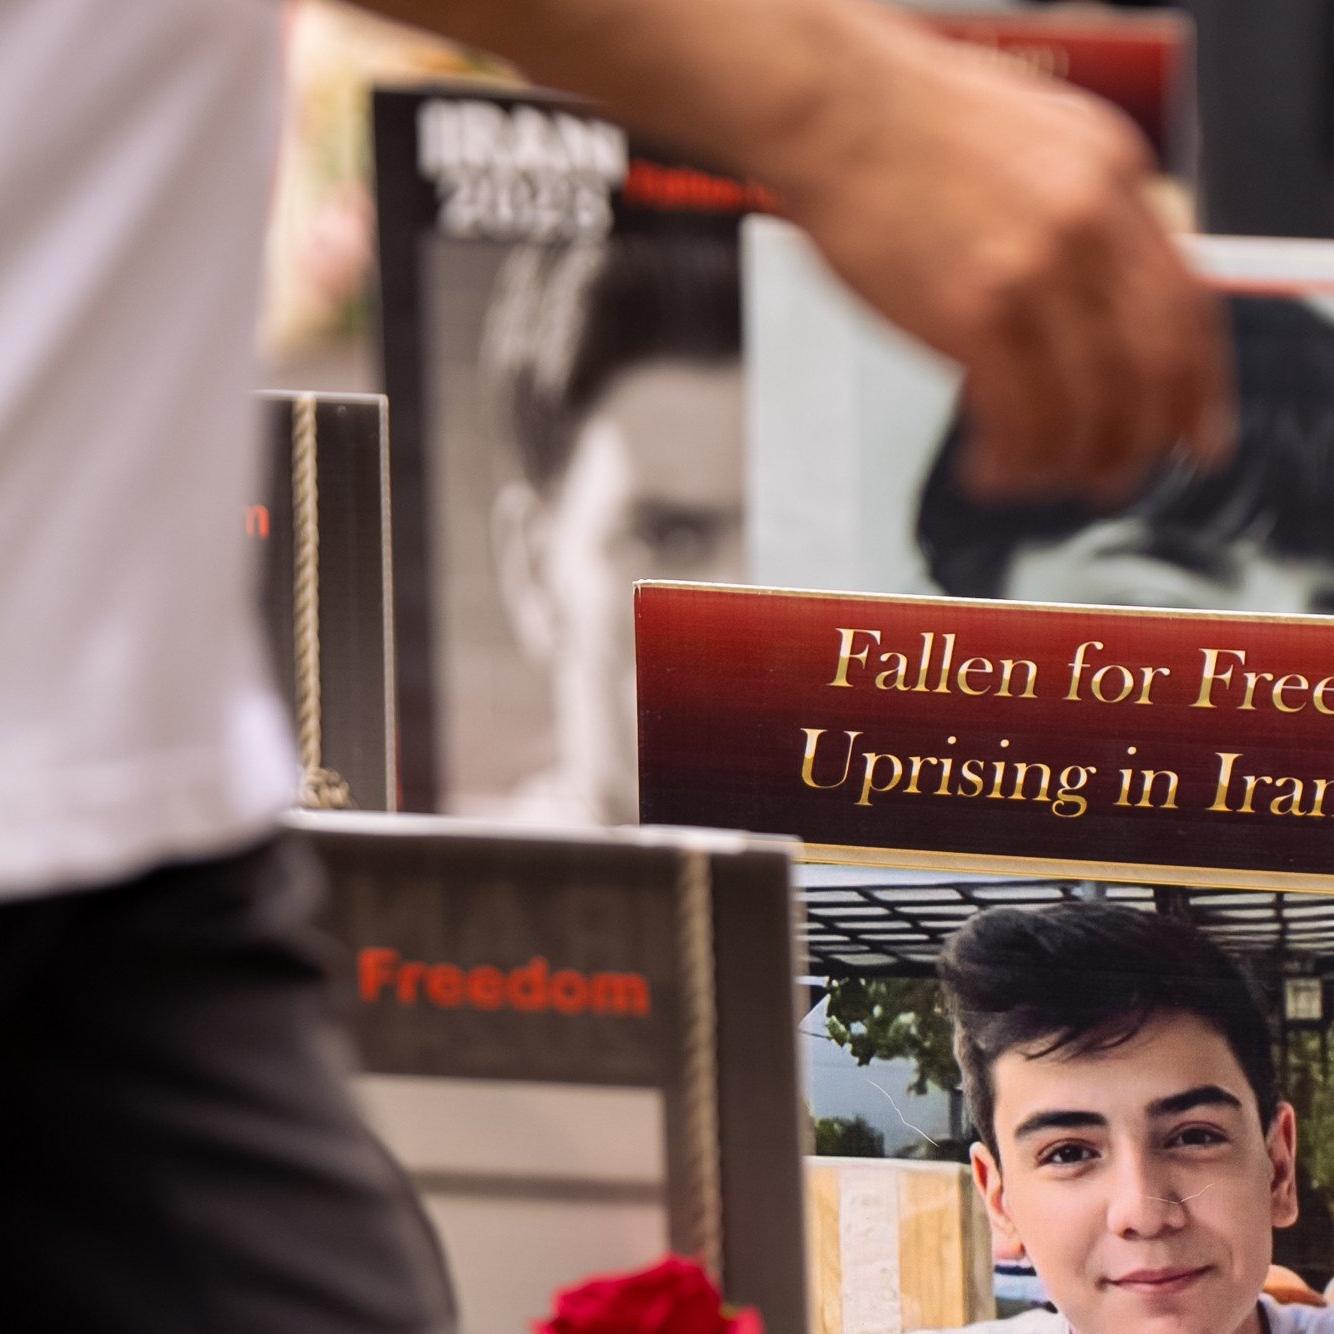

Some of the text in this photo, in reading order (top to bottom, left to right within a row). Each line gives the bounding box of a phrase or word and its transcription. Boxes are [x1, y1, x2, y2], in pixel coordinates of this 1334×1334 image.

[416, 98, 629, 188] IRAN
[826, 627, 1039, 699] Fallen
[1063, 640, 1171, 705] for
[800, 728, 1097, 818] Uprising
[1113, 746, 1179, 809] in
[357, 947, 651, 1018] Freedom
